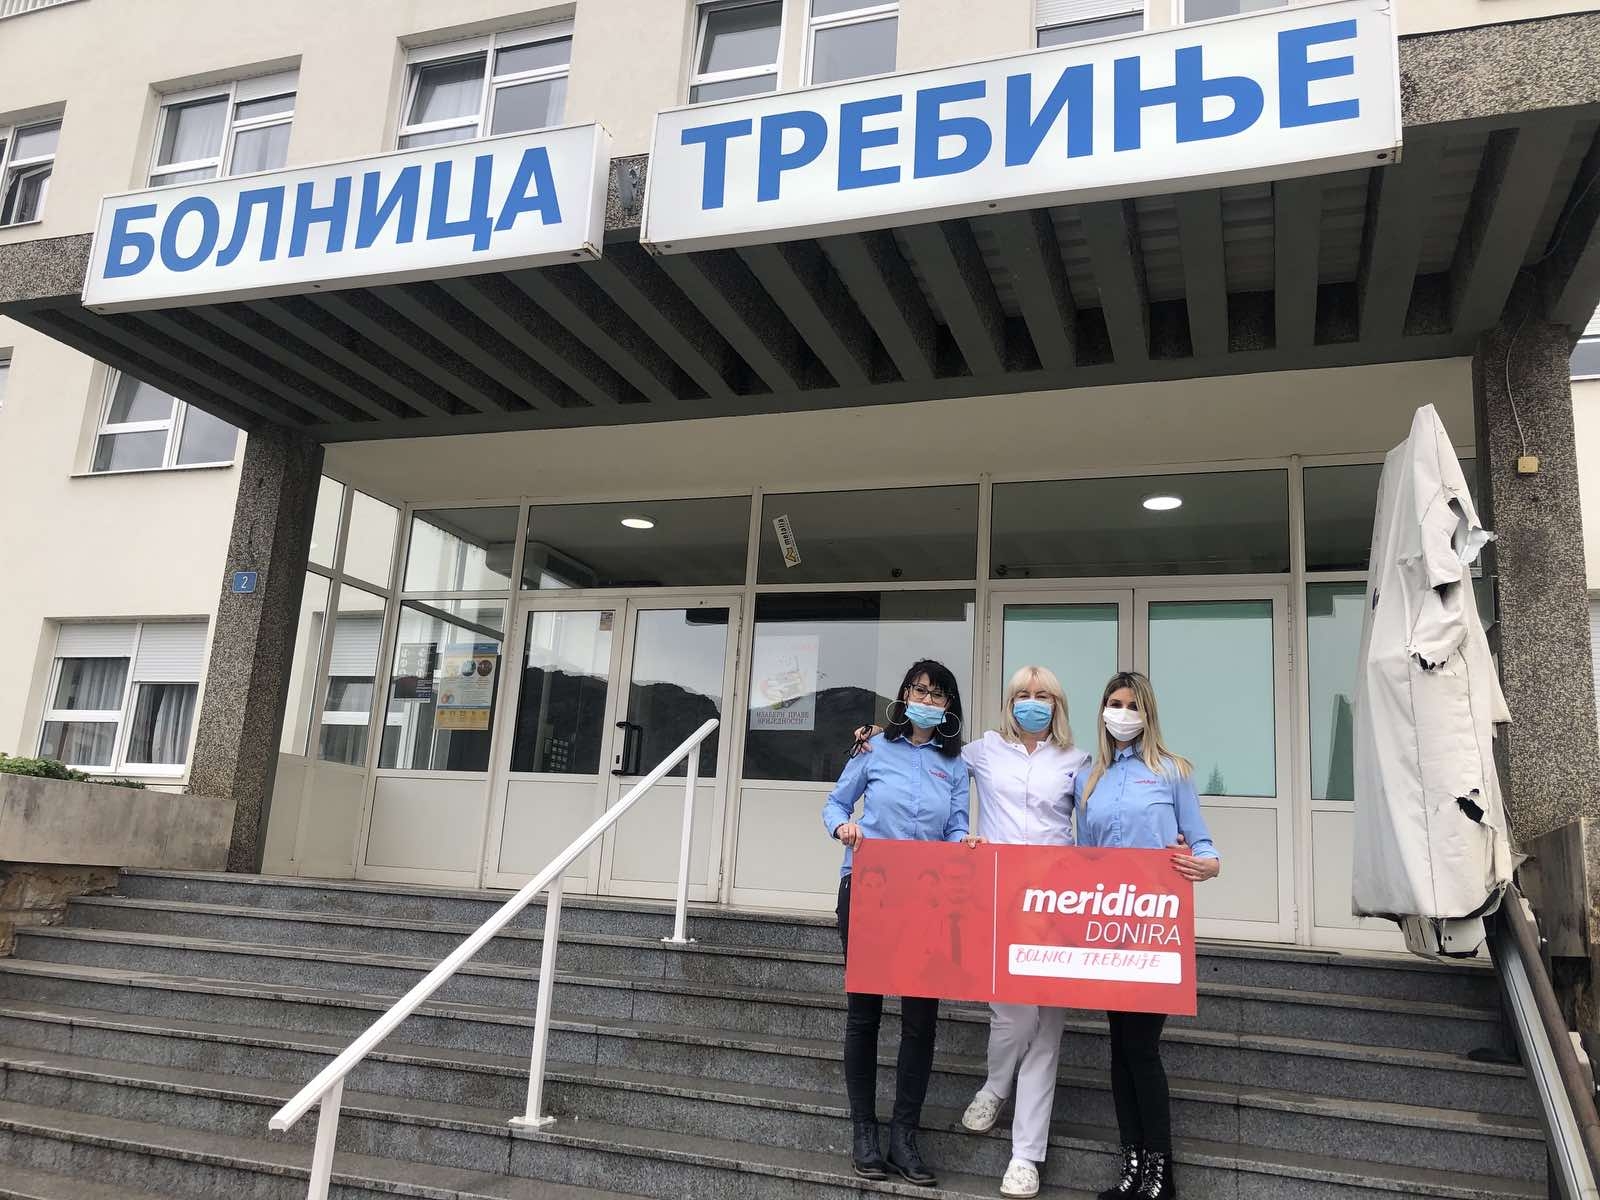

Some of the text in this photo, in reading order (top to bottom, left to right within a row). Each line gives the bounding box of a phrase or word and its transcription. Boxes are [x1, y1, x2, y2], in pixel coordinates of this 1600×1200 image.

[681, 19, 1361, 211] ТРЕБИЊЕ
[103, 146, 562, 279] БОЛНИЦА
[241, 575, 248, 589] 2
[1022, 883, 1180, 919] meridian
[1085, 920, 1182, 946] DONIRA
[1015, 948, 1073, 964] BOLNICI
